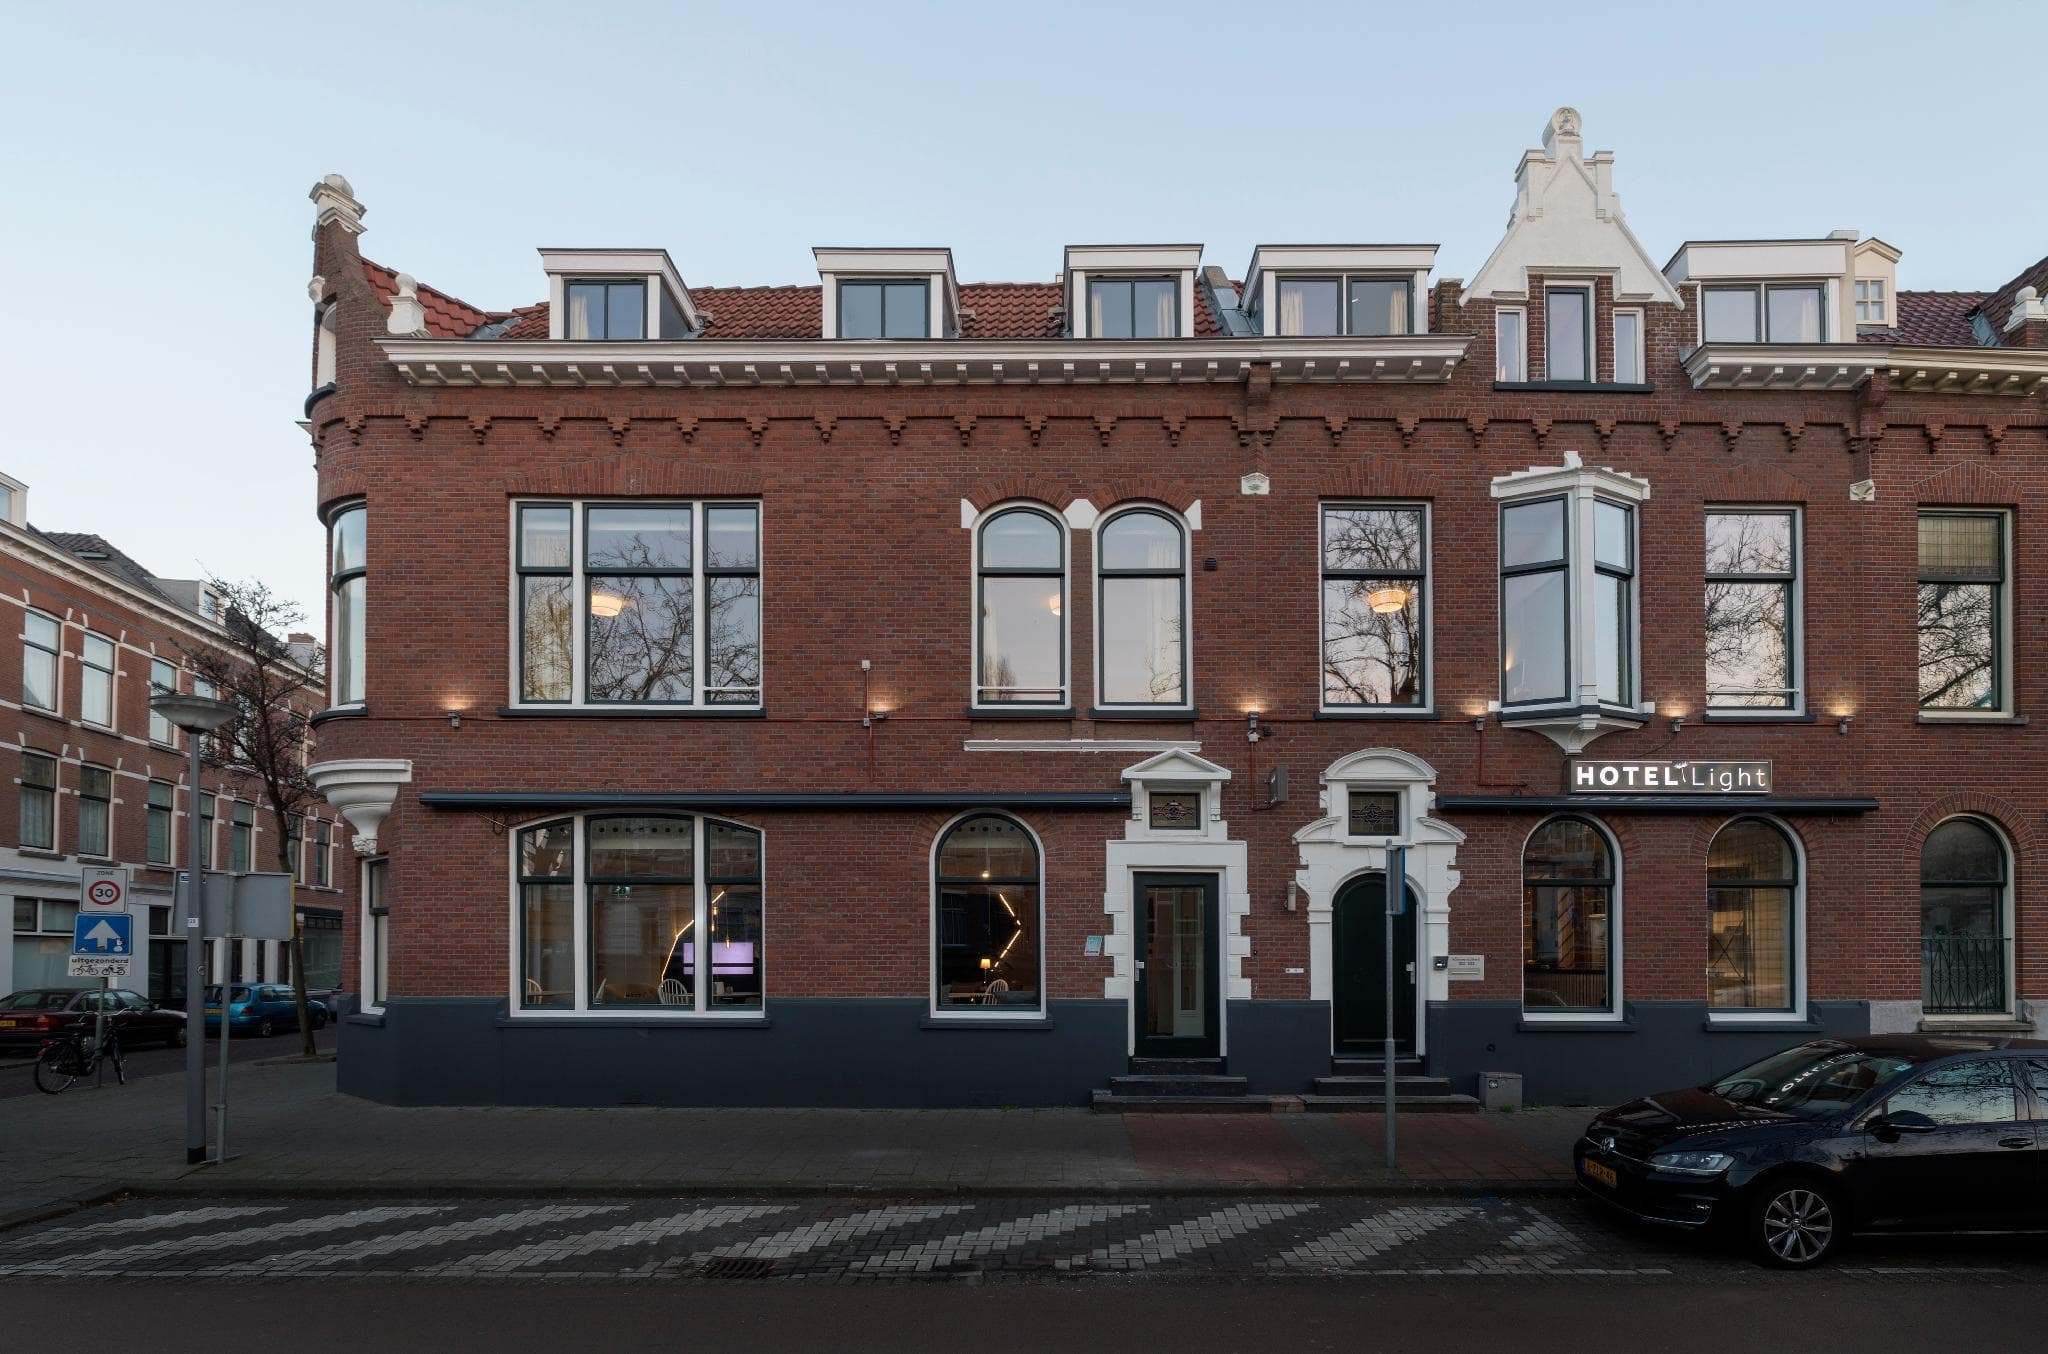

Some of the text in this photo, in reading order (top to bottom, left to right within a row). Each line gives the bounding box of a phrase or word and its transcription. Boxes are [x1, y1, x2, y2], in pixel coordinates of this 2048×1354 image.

[1576, 766, 1766, 792] HOTEL Light
[95, 888, 114, 898] 30
[71, 957, 129, 965] uitgezonderd
